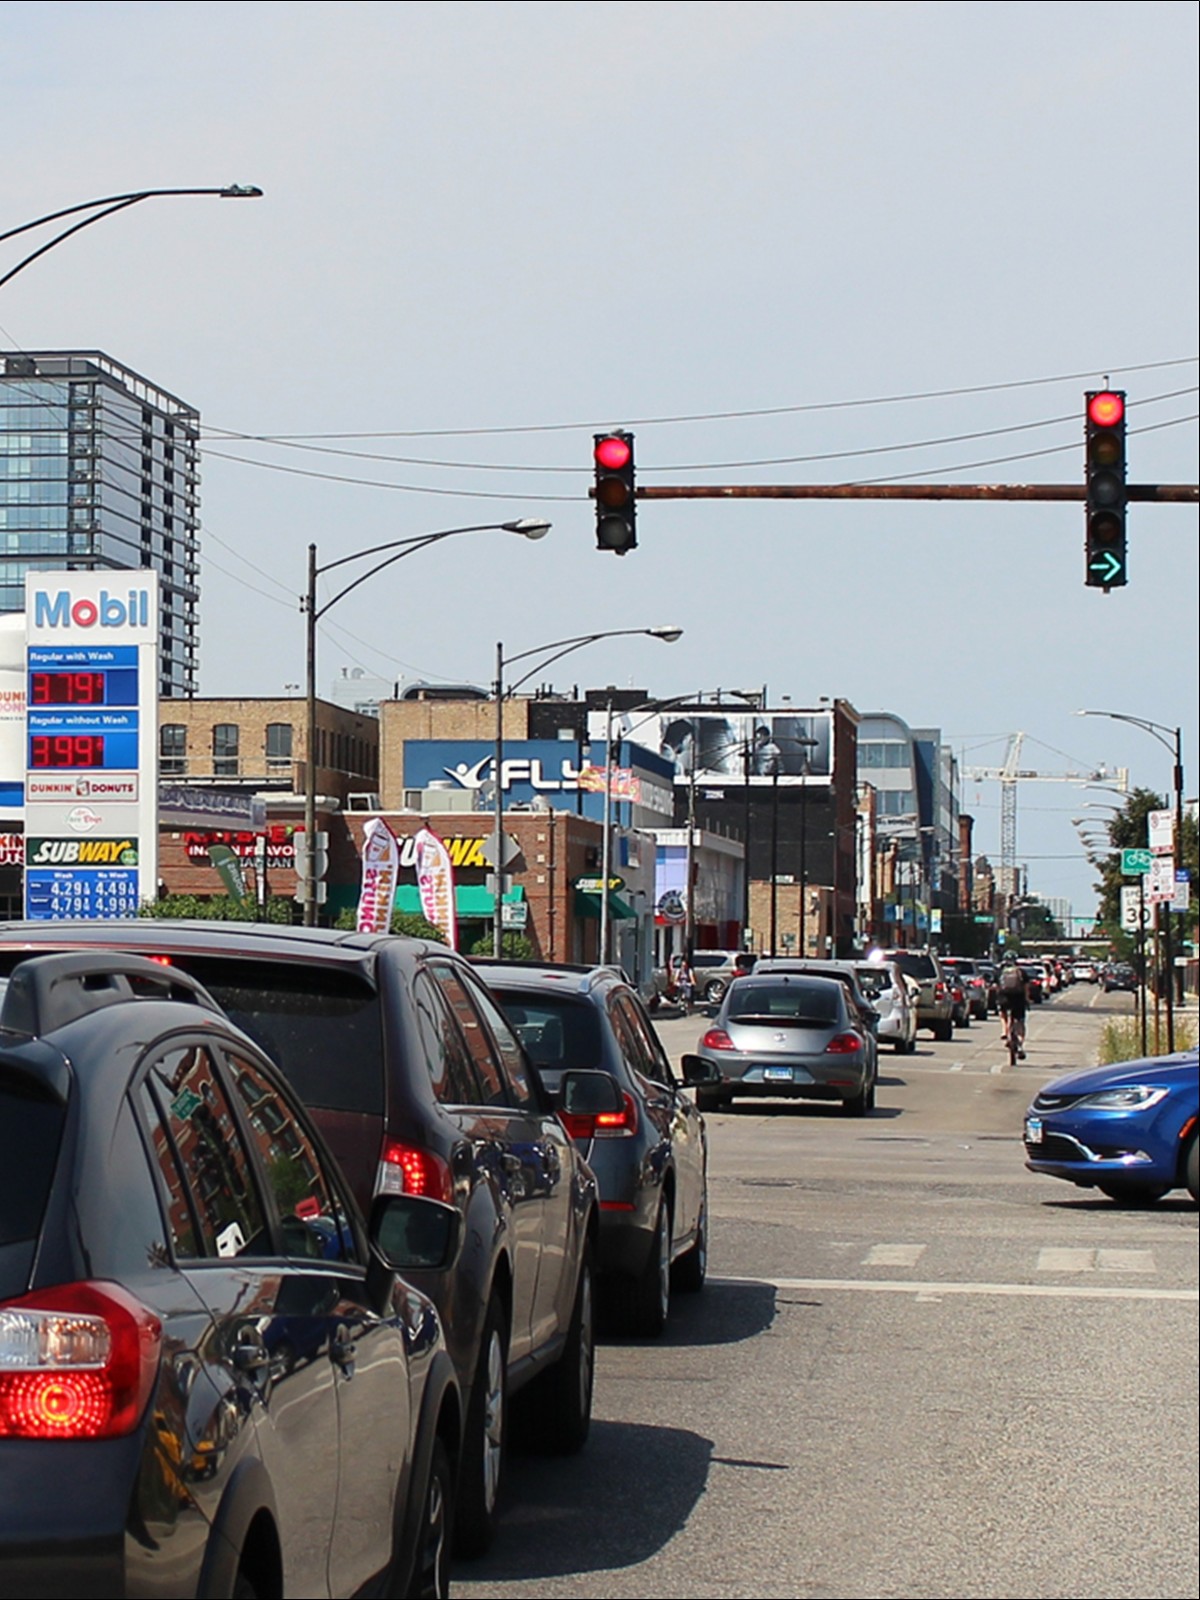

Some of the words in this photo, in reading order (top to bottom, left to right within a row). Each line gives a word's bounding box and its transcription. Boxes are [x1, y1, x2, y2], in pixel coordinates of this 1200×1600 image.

[35, 590, 148, 628] Mobil
[30, 652, 63, 663] Regular
[66, 652, 86, 661] with
[89, 652, 114, 661] Wash
[30, 716, 63, 726] Regular
[66, 716, 100, 724] without
[103, 716, 129, 724] Wash
[30, 784, 75, 793] DUNKIN'
[91, 784, 134, 793] DONUTS
[33, 841, 132, 862] SUBWAY
[51, 882, 82, 896] 4.29
[95, 882, 127, 896] 4.49
[51, 898, 82, 912] 4.79
[95, 898, 127, 912] 4.99
[1126, 908, 1152, 923] 30
